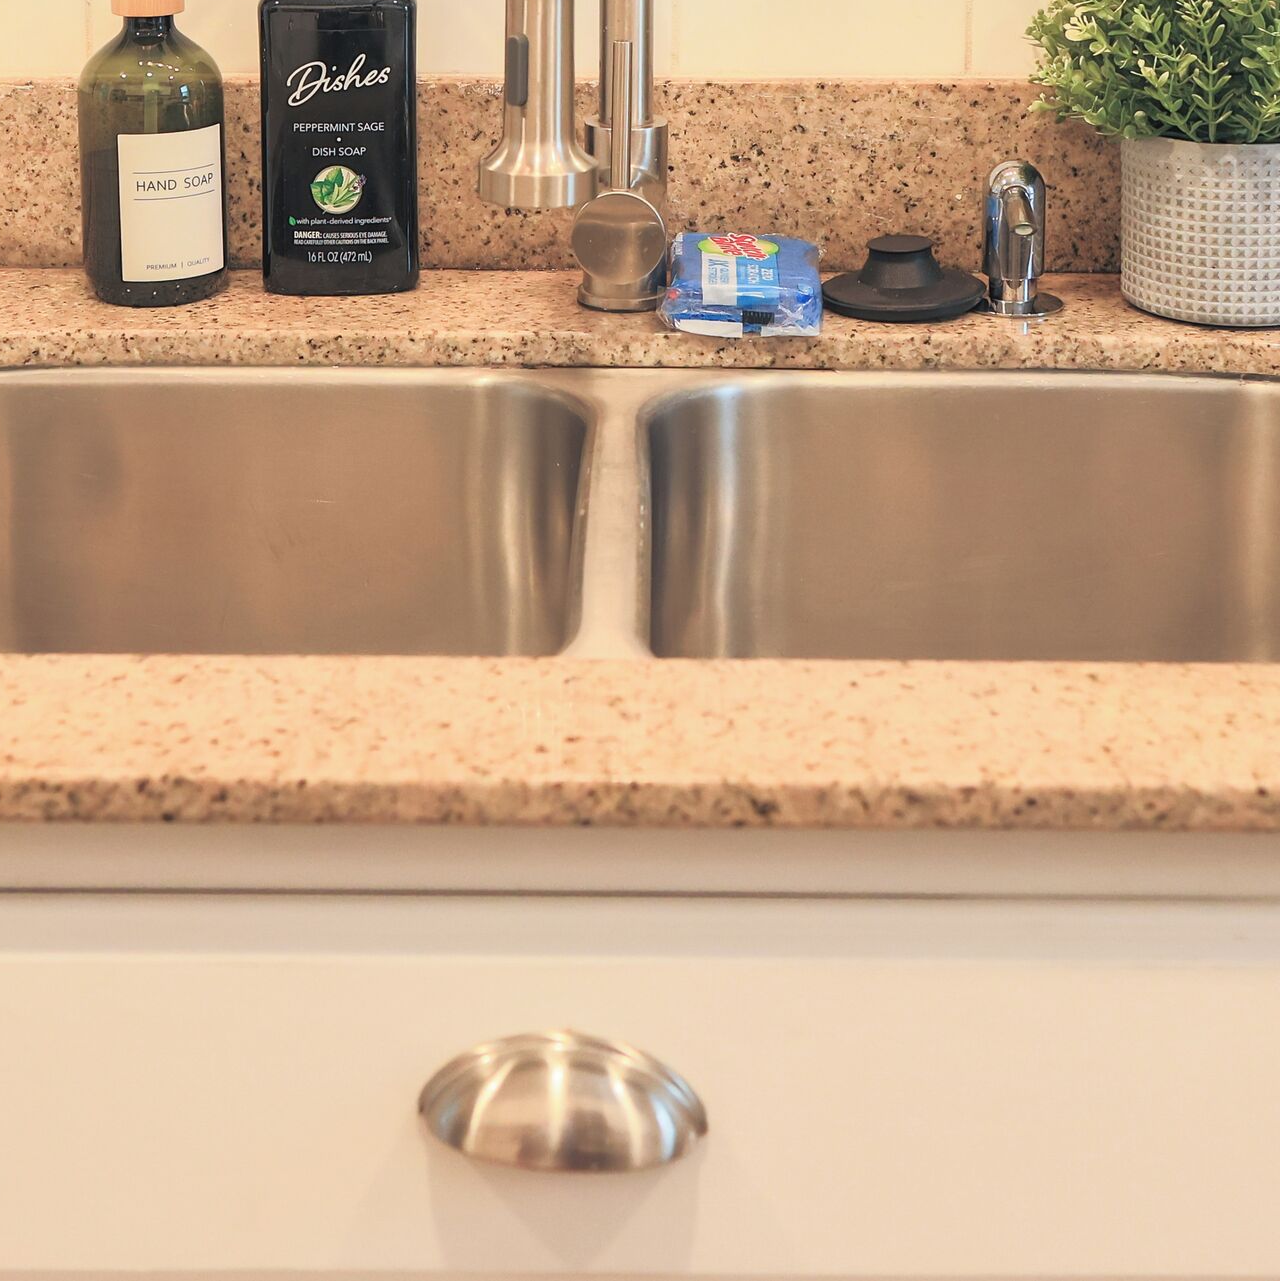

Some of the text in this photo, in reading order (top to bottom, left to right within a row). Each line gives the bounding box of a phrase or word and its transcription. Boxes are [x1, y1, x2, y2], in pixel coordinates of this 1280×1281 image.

[286, 53, 391, 107] Dishes
[293, 122, 385, 132] PEPPERMINT SAGE
[312, 146, 366, 156] DISH SOAP
[136, 172, 213, 191] HAND SOAP
[296, 217, 310, 225] with
[310, 217, 353, 226] plant-derived
[294, 231, 322, 239] DANGER:
[186, 257, 210, 267] QUALITY
[308, 251, 373, 264] 16 FL OZ (472 mL)
